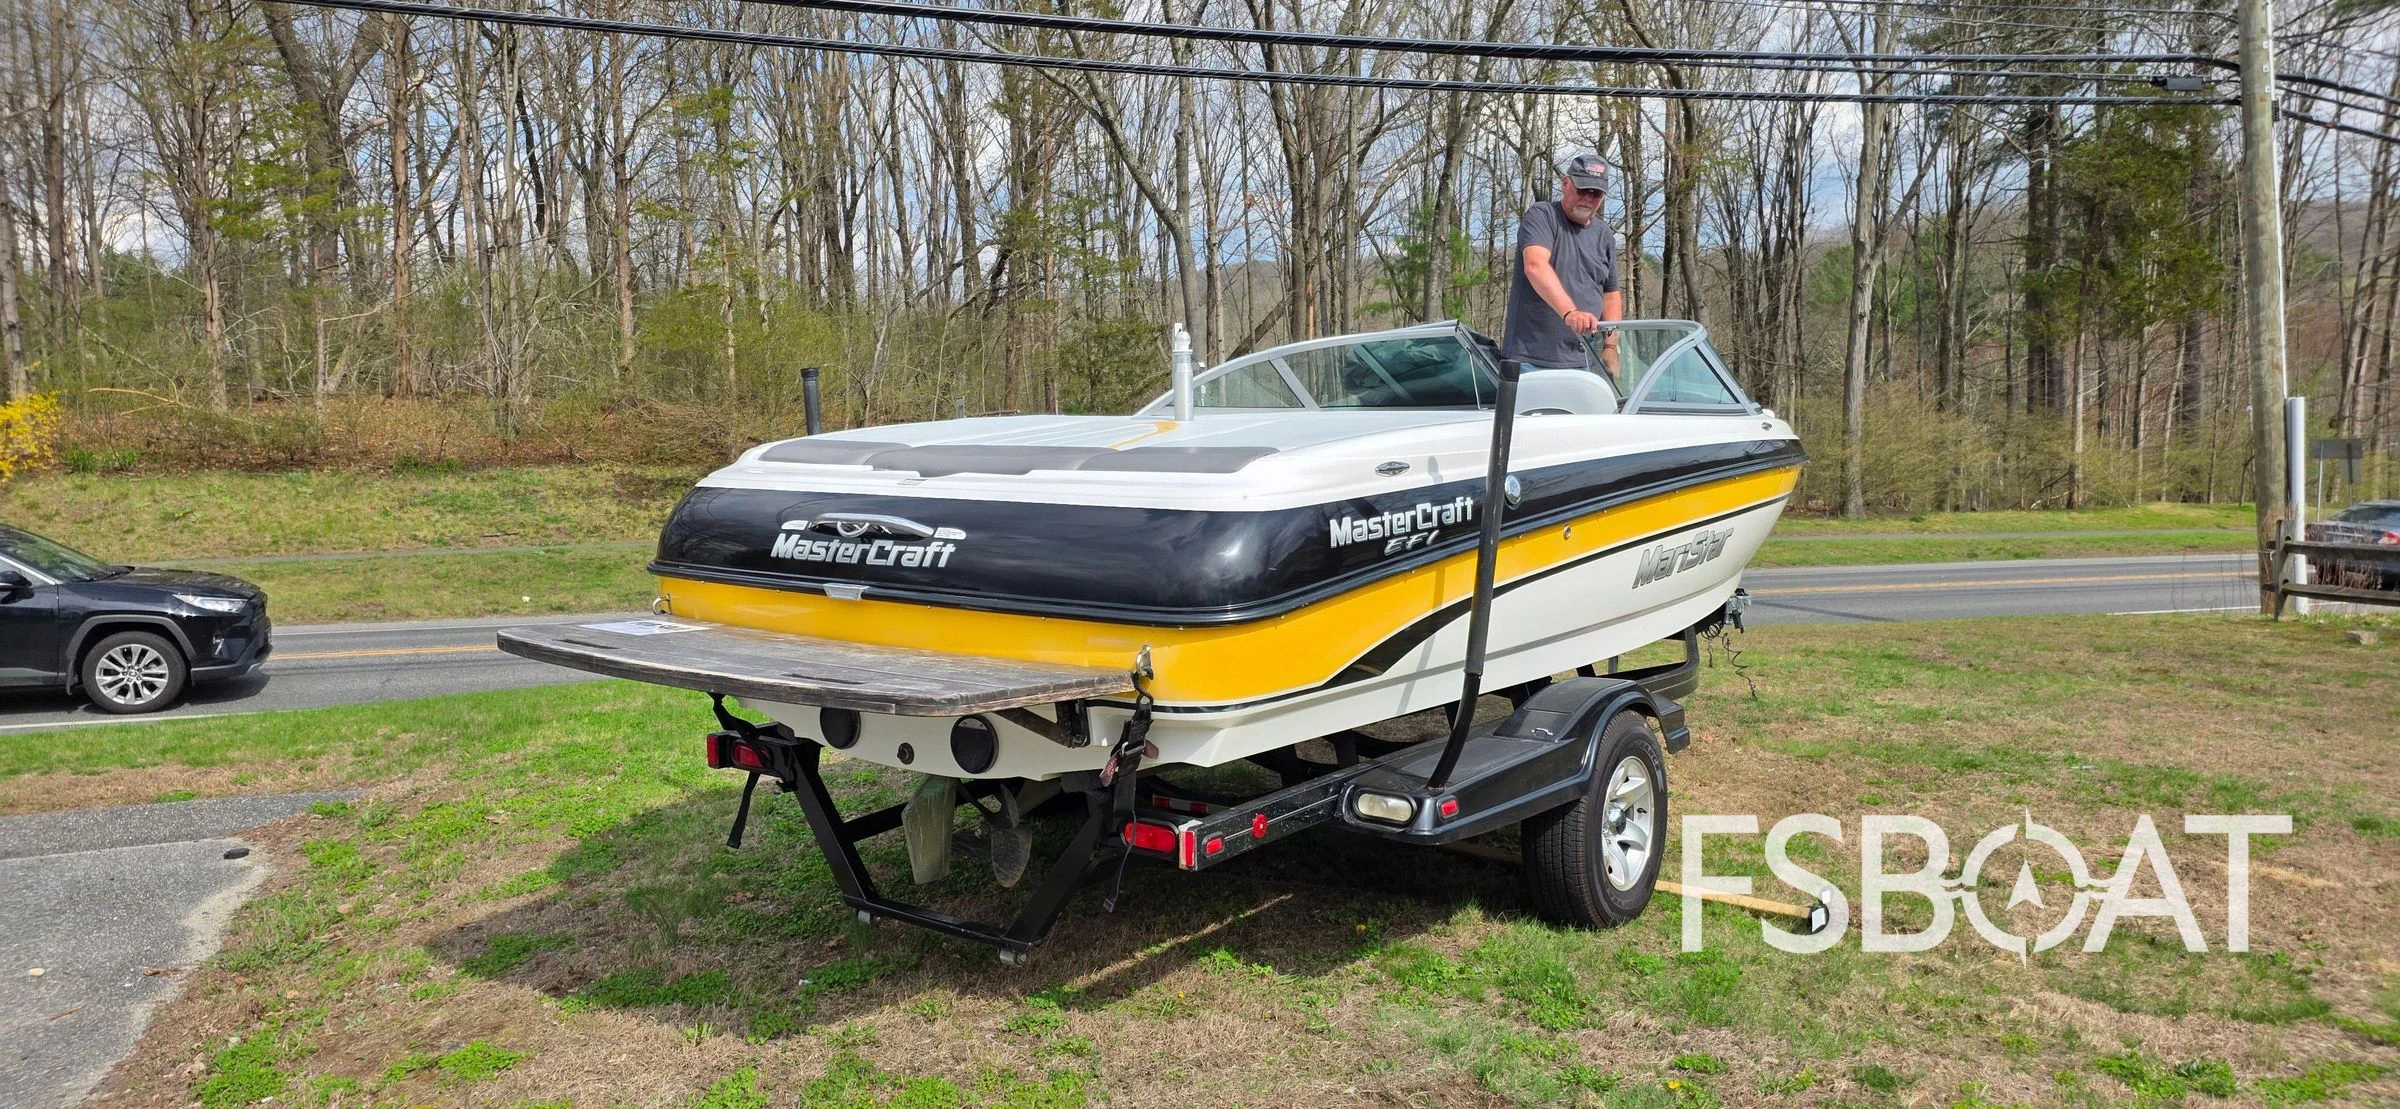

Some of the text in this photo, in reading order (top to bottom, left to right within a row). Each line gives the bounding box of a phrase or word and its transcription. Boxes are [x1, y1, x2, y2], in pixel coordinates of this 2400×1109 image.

[1329, 497, 1473, 548] MasterCraft
[770, 533, 957, 568] MasterCraft
[1631, 527, 1735, 589] MariStar
